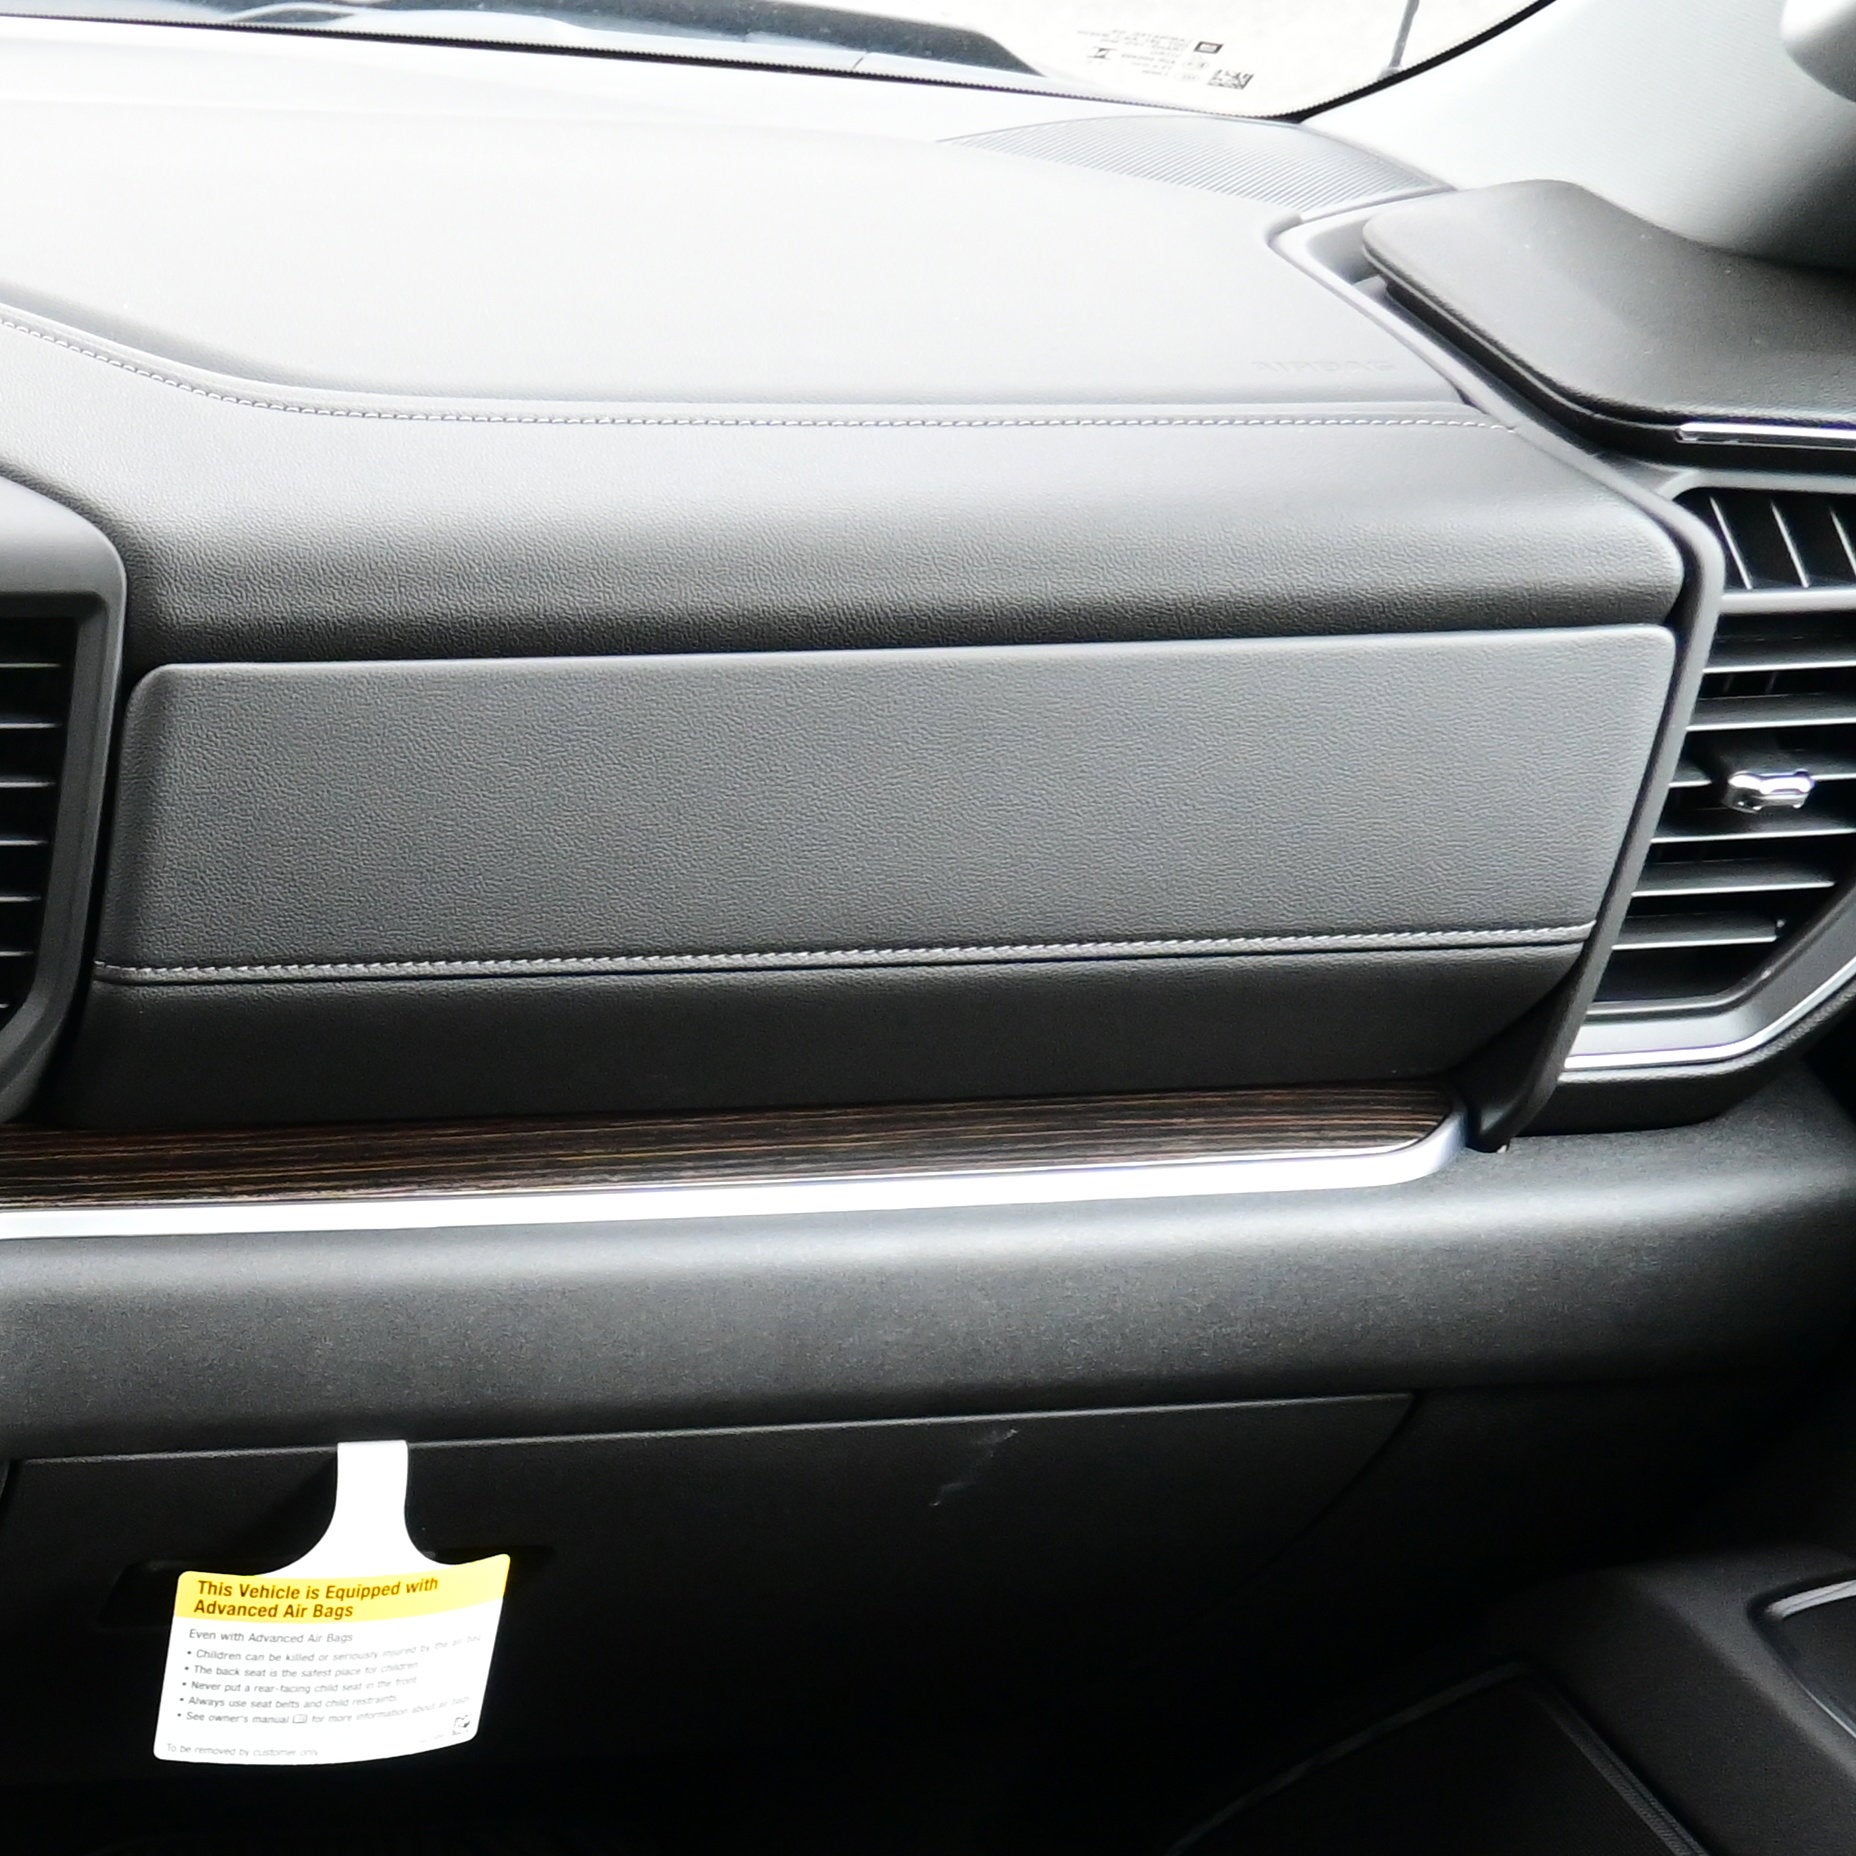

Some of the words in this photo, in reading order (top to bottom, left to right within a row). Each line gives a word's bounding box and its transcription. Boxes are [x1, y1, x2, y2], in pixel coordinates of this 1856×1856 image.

[197, 1579, 233, 1597] This
[239, 1582, 301, 1600] Vehicle
[305, 1585, 320, 1600] is
[325, 1581, 400, 1602] Equipped
[406, 1577, 439, 1595] with
[193, 1599, 278, 1618] Advanced
[282, 1602, 309, 1619] Air
[312, 1603, 354, 1621] Bags
[189, 1628, 217, 1641] Even
[220, 1631, 245, 1642] with
[248, 1631, 304, 1644] Advanced
[307, 1633, 323, 1643] Air
[326, 1633, 353, 1645] Bags
[196, 1649, 241, 1661] Children
[245, 1653, 265, 1662] can
[268, 1652, 282, 1662] be
[285, 1651, 315, 1662] killed
[318, 1654, 329, 1662] or
[332, 1650, 379, 1663] seriously
[194, 1664, 212, 1675] The
[216, 1665, 240, 1676] back
[244, 1667, 266, 1677] seat
[281, 1667, 298, 1677] the
[301, 1667, 331, 1677] safest
[191, 1680, 222, 1692] Never
[224, 1683, 242, 1694] put
[253, 1684, 311, 1695] rear-facing
[314, 1683, 339, 1693] child
[342, 1682, 363, 1691] seat
[188, 1696, 225, 1708] Always
[228, 1699, 248, 1708] use
[250, 1699, 272, 1709] seat
[275, 1698, 300, 1709] belts
[303, 1699, 322, 1708] and
[325, 1697, 349, 1707] child
[186, 1711, 205, 1722] See
[208, 1713, 249, 1723] owner's
[252, 1714, 290, 1724] manual
[328, 1714, 352, 1722] more
